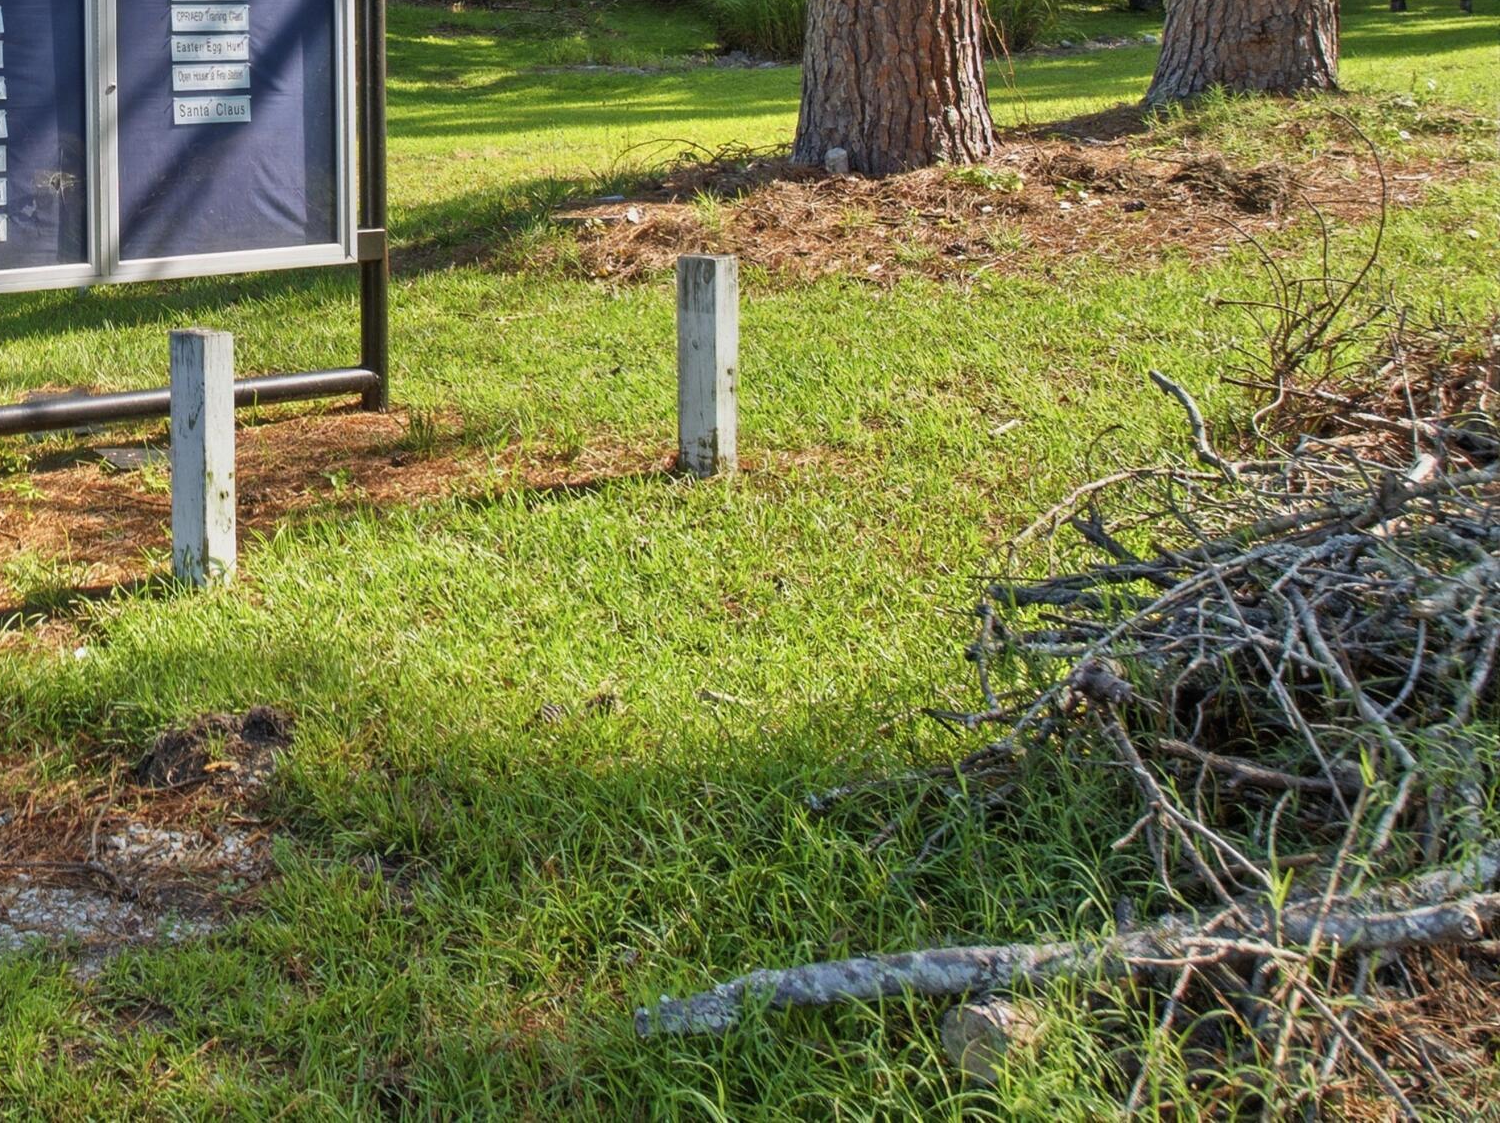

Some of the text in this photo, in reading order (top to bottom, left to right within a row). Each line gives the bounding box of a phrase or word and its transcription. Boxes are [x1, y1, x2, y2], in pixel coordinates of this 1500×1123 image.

[176, 40, 245, 55] Easter Egg Hunt
[179, 102, 246, 118] Santa Claus
